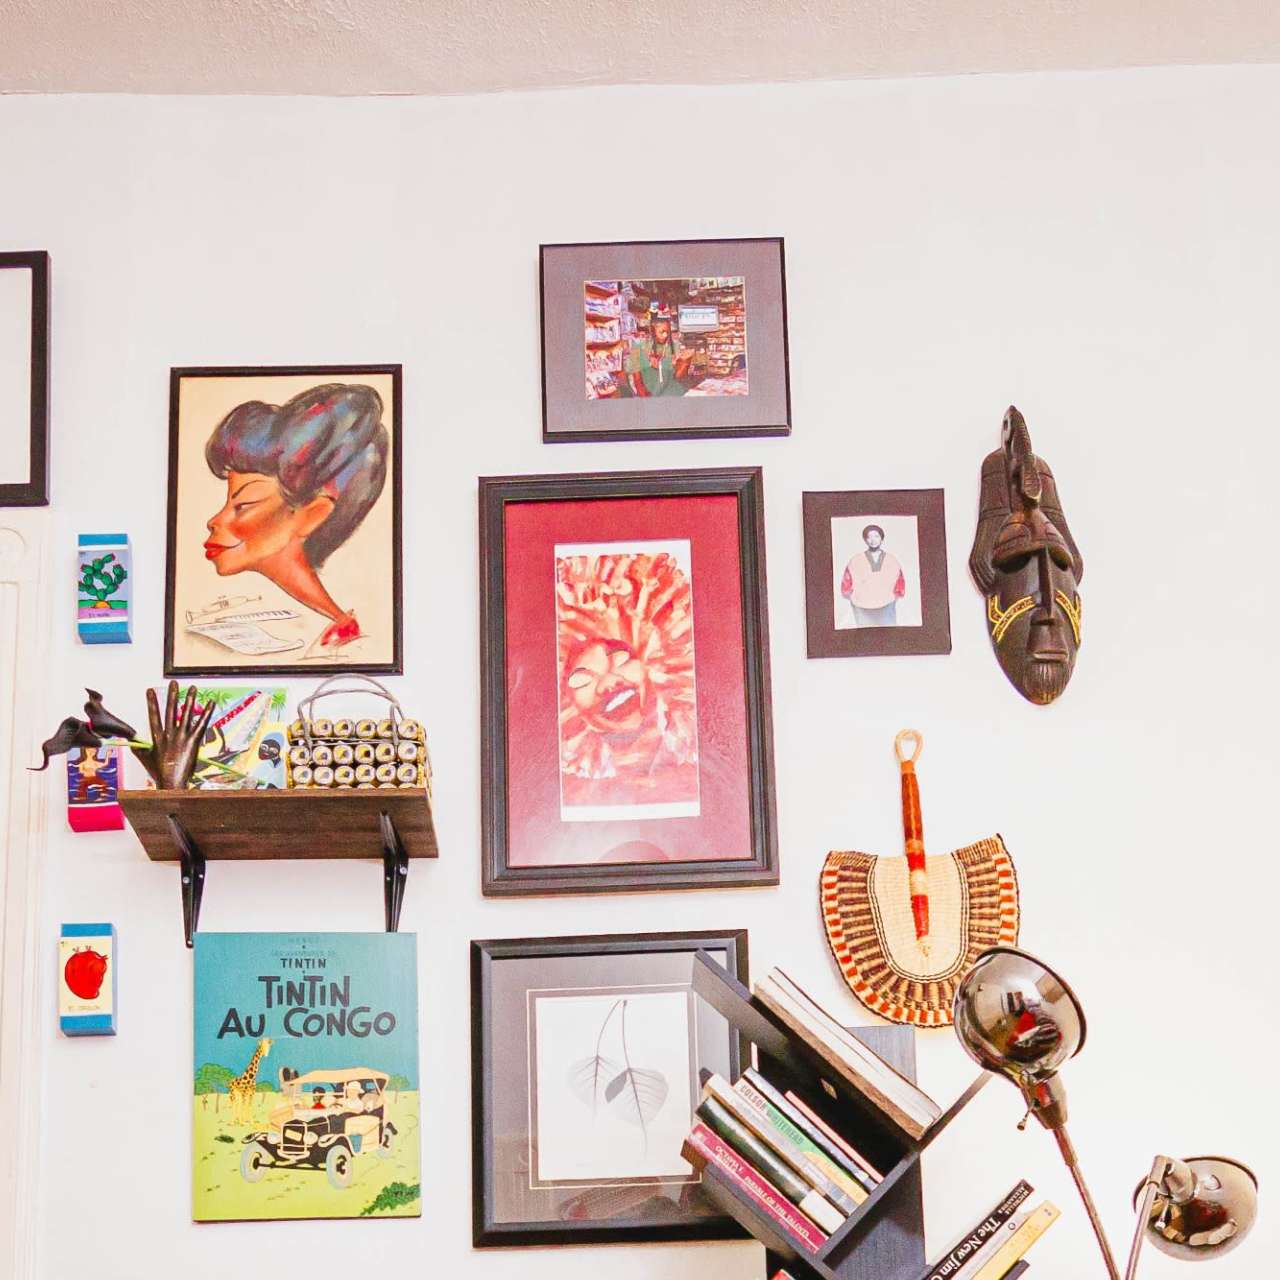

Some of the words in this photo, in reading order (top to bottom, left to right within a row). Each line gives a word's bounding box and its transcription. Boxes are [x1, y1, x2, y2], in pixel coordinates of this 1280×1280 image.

[280, 958, 326, 969] TINTIN
[258, 975, 350, 1008] TINTIN
[217, 1008, 266, 1039] AU
[283, 1007, 396, 1038] CONGO
[740, 1084, 767, 1111] COLSON
[766, 1107, 805, 1145] WHITEHEAD
[978, 1216, 1001, 1237] The
[957, 1237, 983, 1259] New
[939, 1252, 962, 1276] Jim
